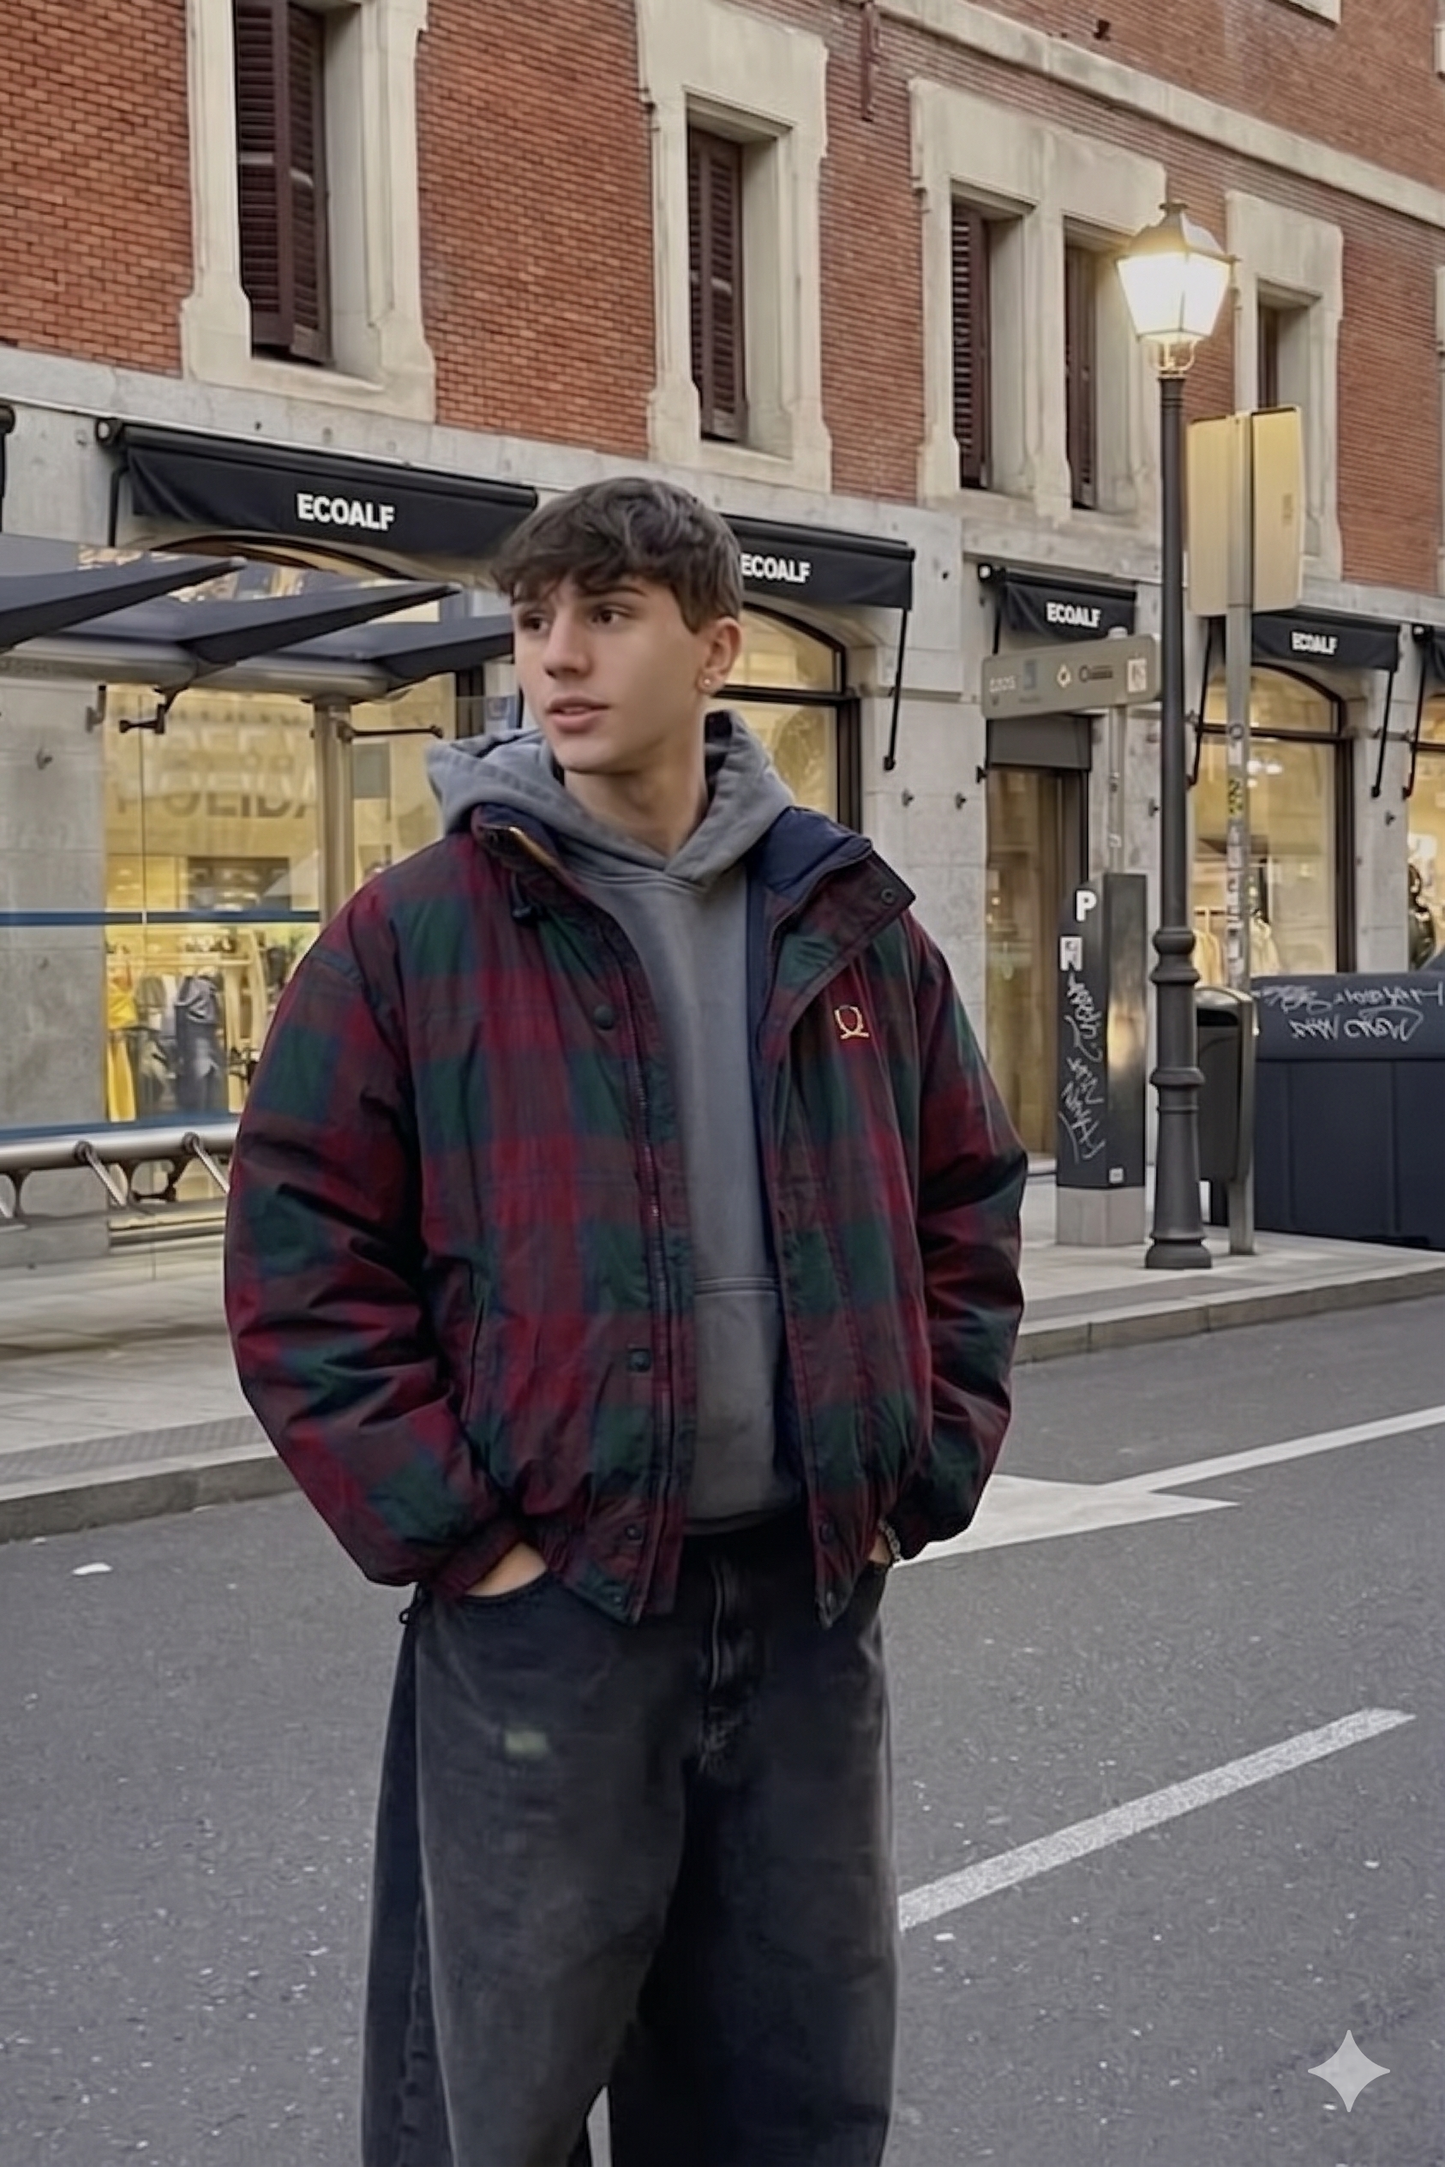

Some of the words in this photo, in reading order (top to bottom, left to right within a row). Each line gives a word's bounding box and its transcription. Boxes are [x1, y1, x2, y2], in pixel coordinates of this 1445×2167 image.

[296, 492, 395, 531] ECOALF
[740, 553, 812, 583] ECOALF
[1046, 602, 1101, 627] ECOALF
[1291, 632, 1338, 655] ECOALF
[1075, 890, 1097, 922] P
